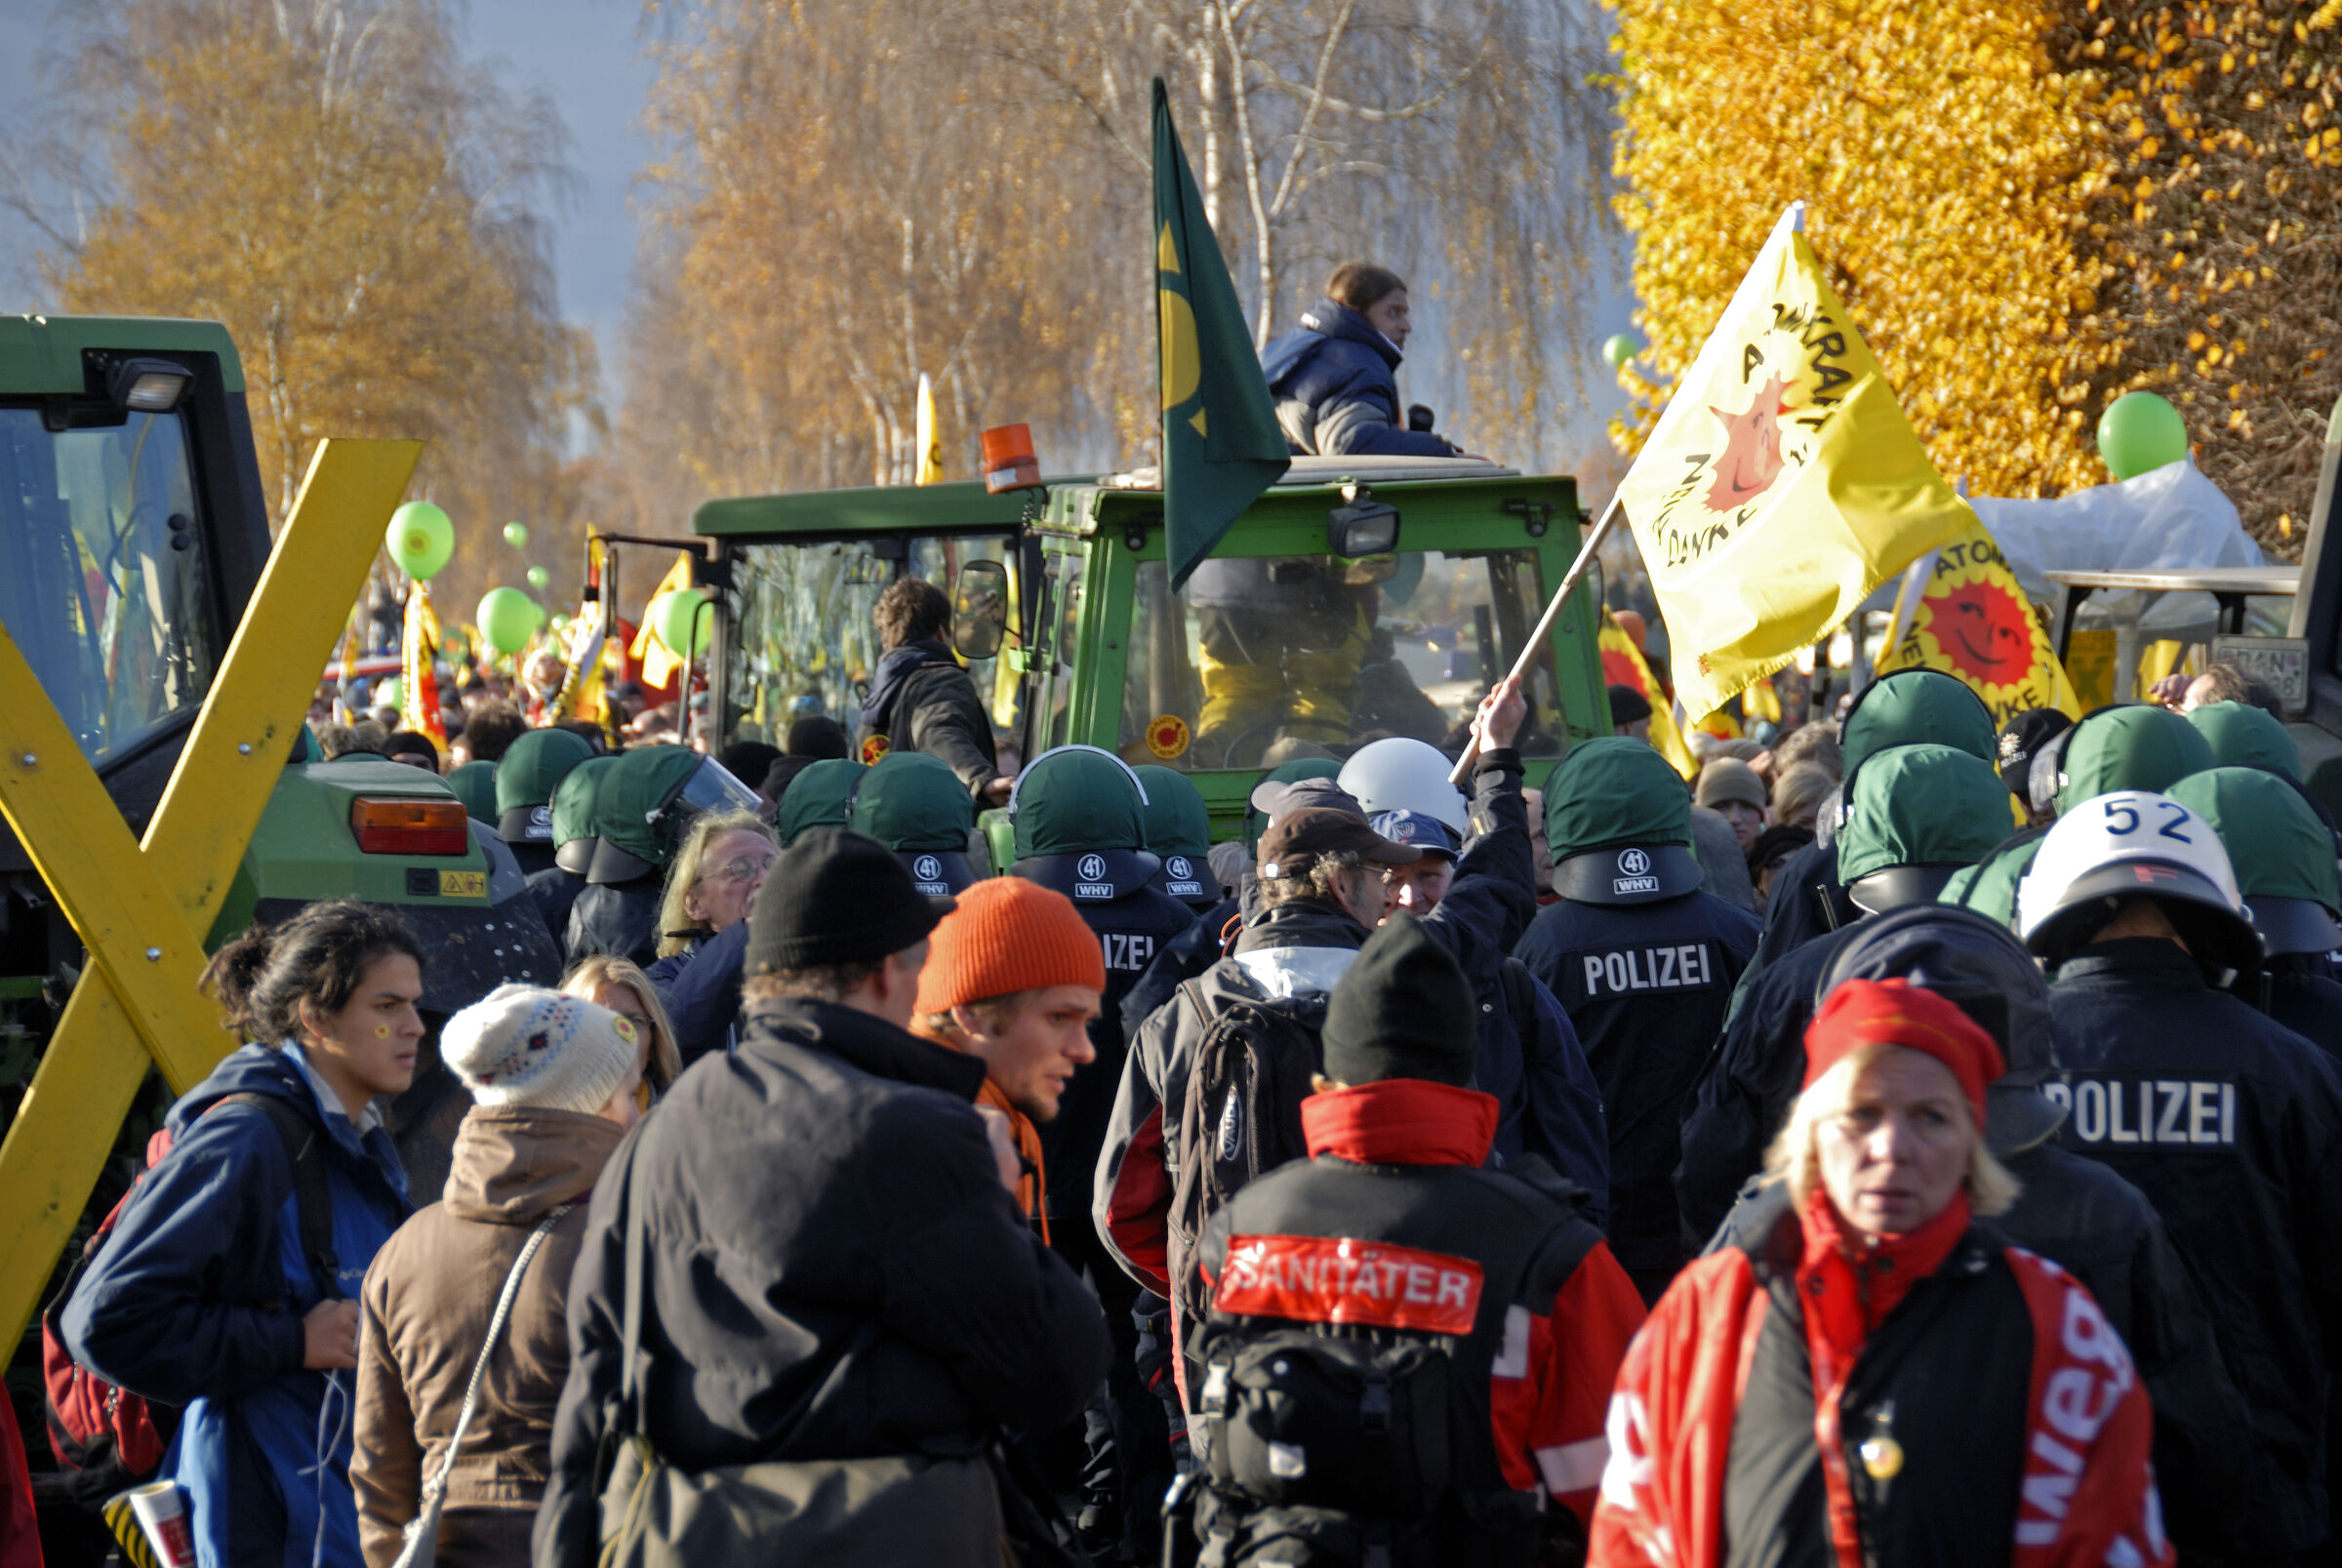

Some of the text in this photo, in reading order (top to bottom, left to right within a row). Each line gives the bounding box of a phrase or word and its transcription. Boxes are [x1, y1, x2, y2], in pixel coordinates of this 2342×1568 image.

[919, 859, 938, 877] 41
[1083, 858, 1101, 877] 41
[1172, 859, 1189, 876] 41
[1624, 851, 1646, 872] 41
[1078, 885, 1110, 896] WHV
[1170, 883, 1199, 894] WHV
[1617, 878, 1655, 892] WHV
[1103, 933, 1154, 970] IZEI
[1583, 944, 1712, 995] POLIZEI
[2042, 1079, 2235, 1143] POLIZEI
[1232, 1250, 1471, 1307] SANITÄTER
